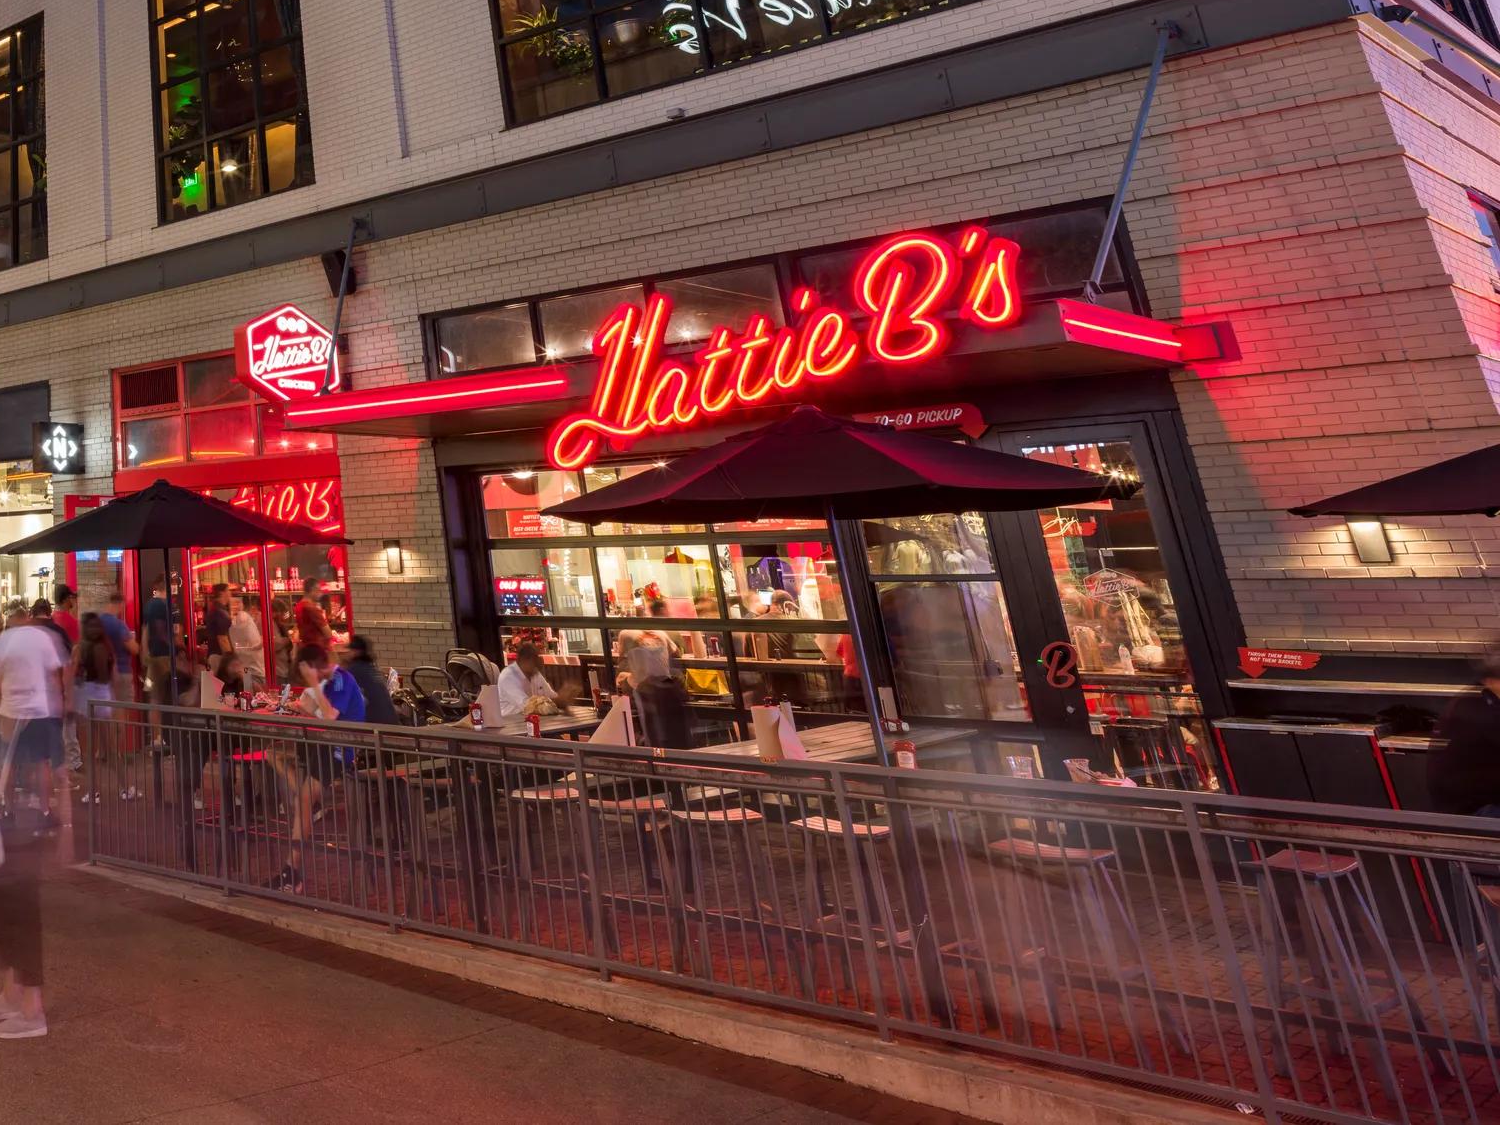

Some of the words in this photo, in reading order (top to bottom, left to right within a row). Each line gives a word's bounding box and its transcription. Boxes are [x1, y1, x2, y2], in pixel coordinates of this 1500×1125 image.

[550, 288, 860, 470] Hattie
[856, 226, 1021, 365] B's
[916, 408, 963, 423] PICKUP
[1041, 641, 1078, 689] B
